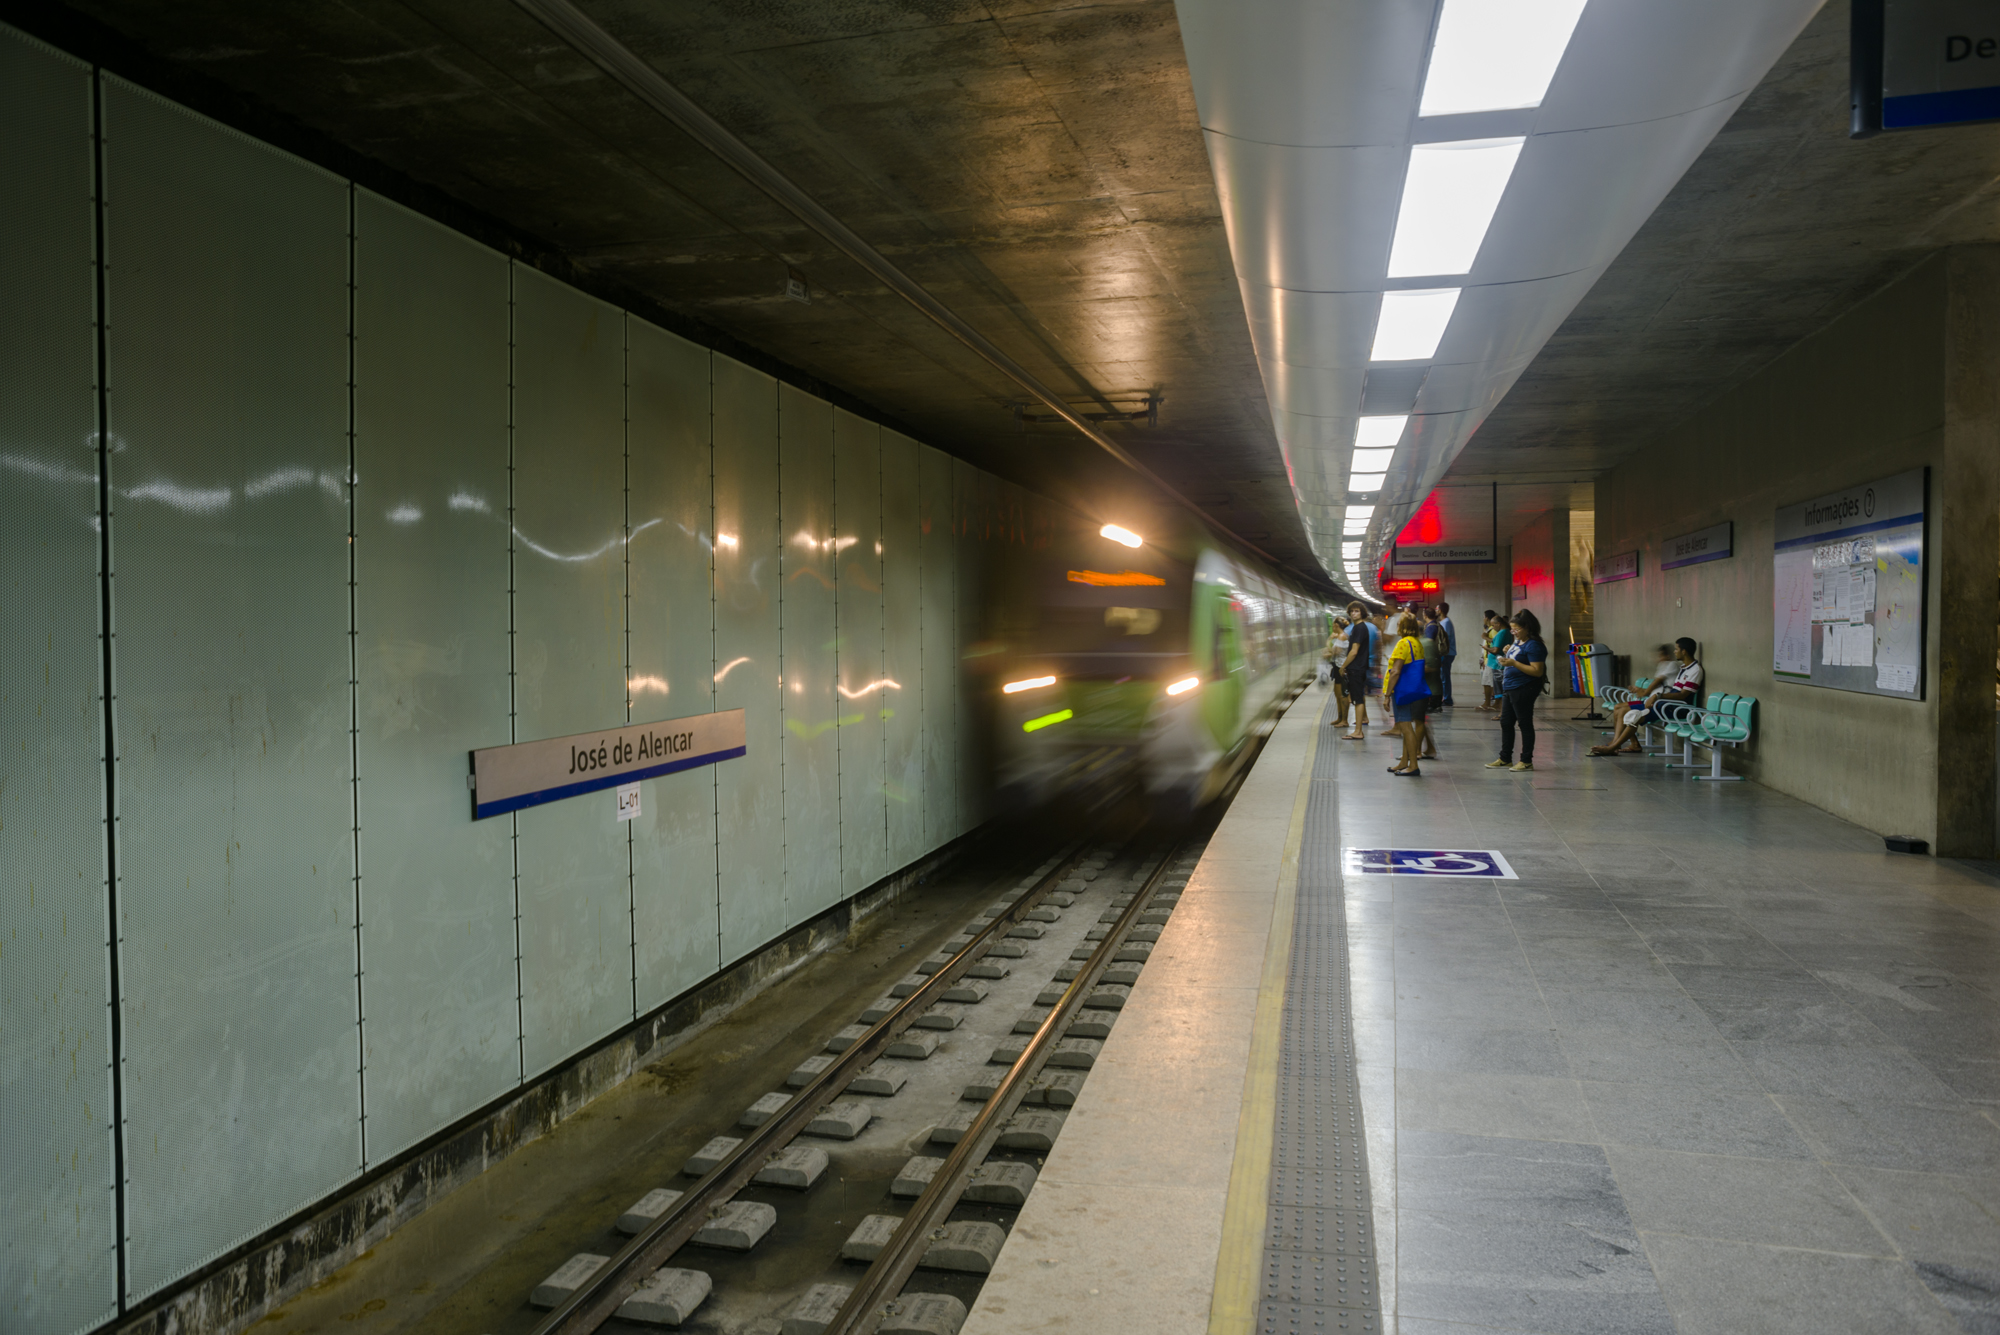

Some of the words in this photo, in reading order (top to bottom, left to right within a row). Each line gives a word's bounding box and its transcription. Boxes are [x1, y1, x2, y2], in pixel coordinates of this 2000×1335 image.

[1945, 35, 2000, 63] De
[1804, 497, 1860, 527] Informações
[1422, 550, 1447, 558] Carlito
[1449, 549, 1488, 557] Benevides
[569, 739, 608, 774] José
[613, 736, 633, 765] de
[637, 731, 694, 761] Alencar
[619, 791, 639, 811] L-01
